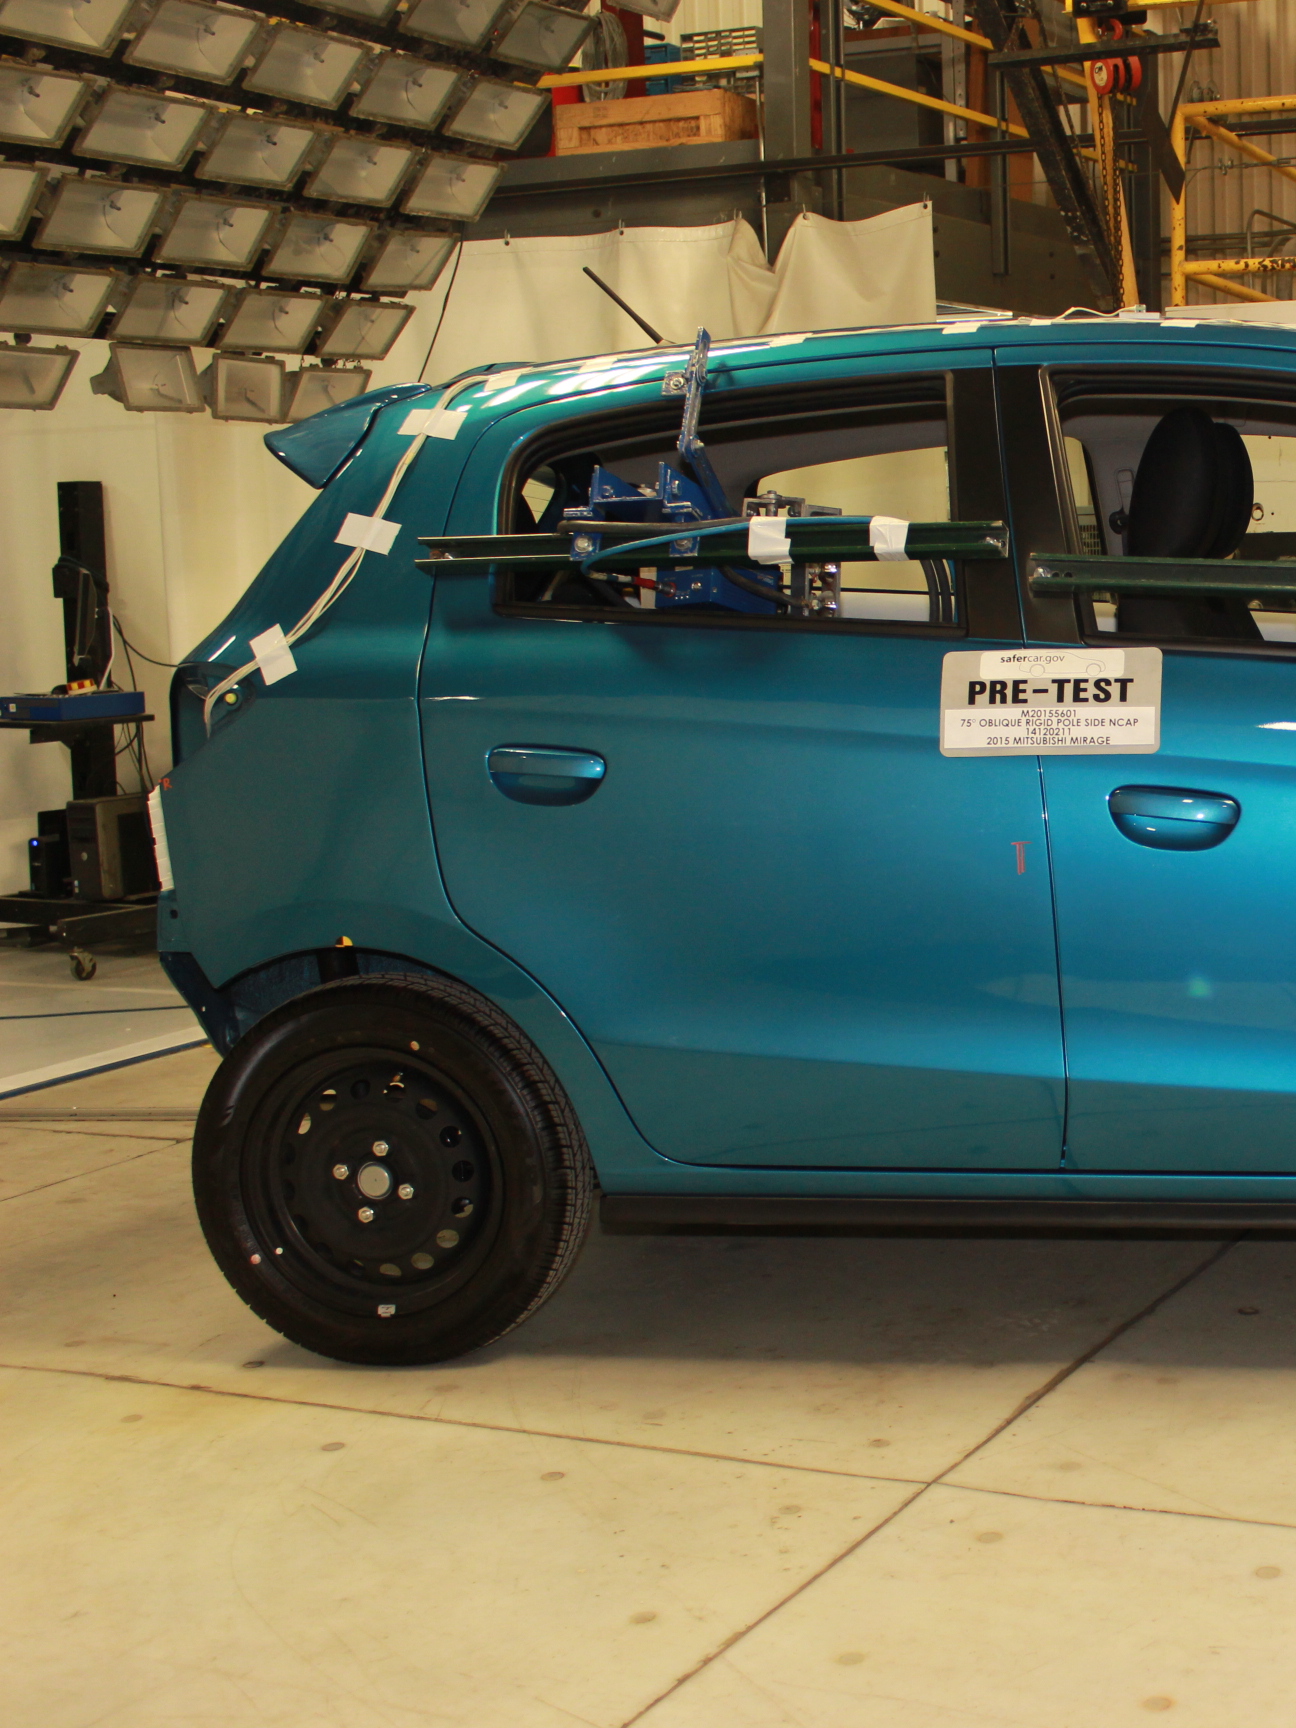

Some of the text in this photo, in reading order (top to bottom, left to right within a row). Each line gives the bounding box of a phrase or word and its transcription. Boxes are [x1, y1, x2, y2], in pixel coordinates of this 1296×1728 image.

[1000, 654, 1065, 664] safercar.gov
[968, 678, 1134, 705] PRE-TEST
[1021, 709, 1076, 718] M20155601
[960, 718, 1139, 727] 75° OBLIQUE RIGID POLE SIDE NCAP
[1026, 727, 1071, 736] 14120211
[986, 736, 1111, 745] 2015 MITSUBISHI MIRAGE
